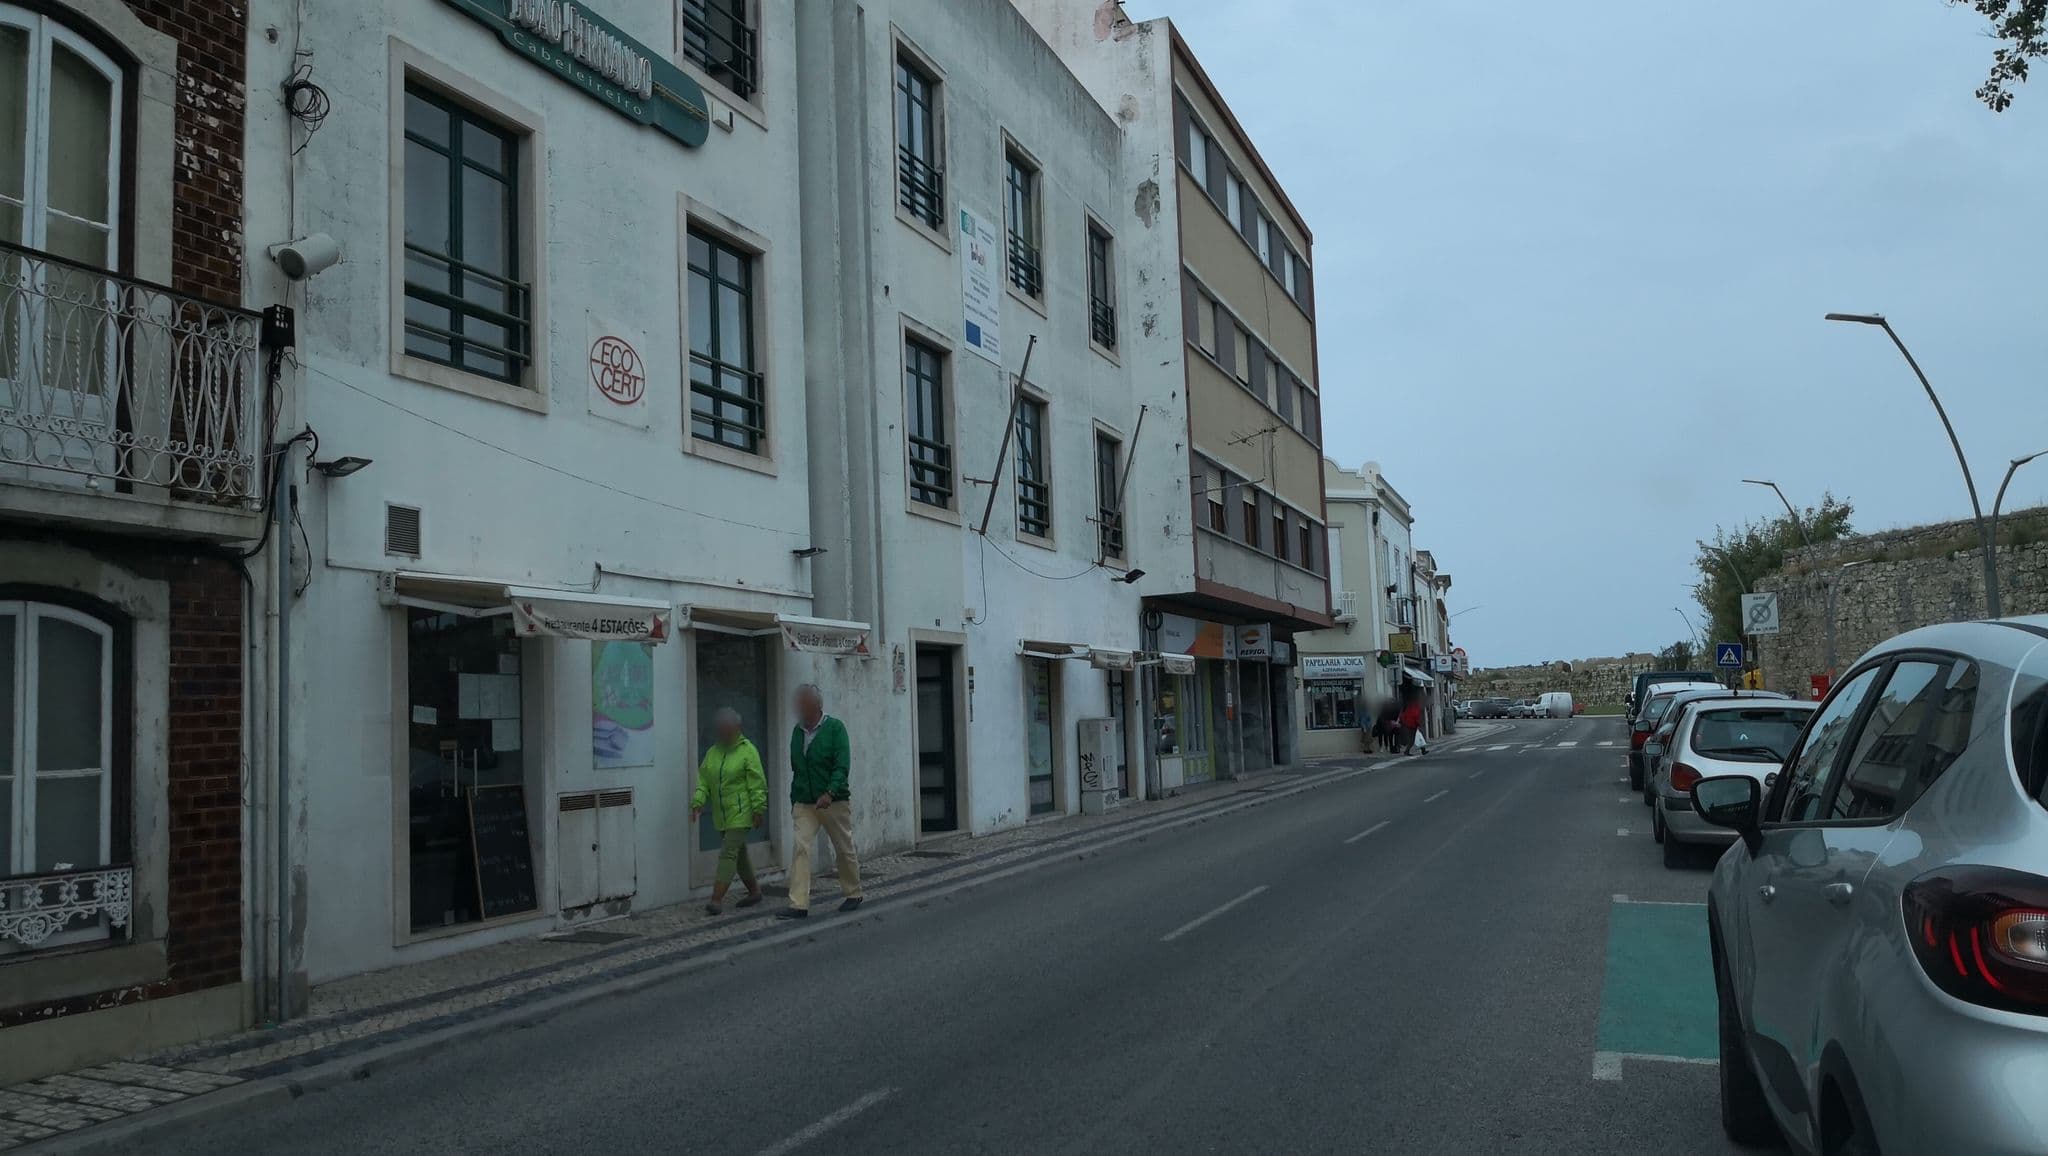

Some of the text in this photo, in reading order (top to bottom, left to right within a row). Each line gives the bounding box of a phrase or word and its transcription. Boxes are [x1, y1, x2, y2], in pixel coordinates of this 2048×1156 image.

[512, 31, 643, 115] Cabeleireiro
[601, 342, 634, 373] ECO
[601, 366, 639, 398] CERT
[591, 618, 598, 633] 4
[600, 618, 649, 634] ESTAÇÕES
[1240, 648, 1266, 656] REPSOL
[1305, 658, 1341, 667] PAPELARIA
